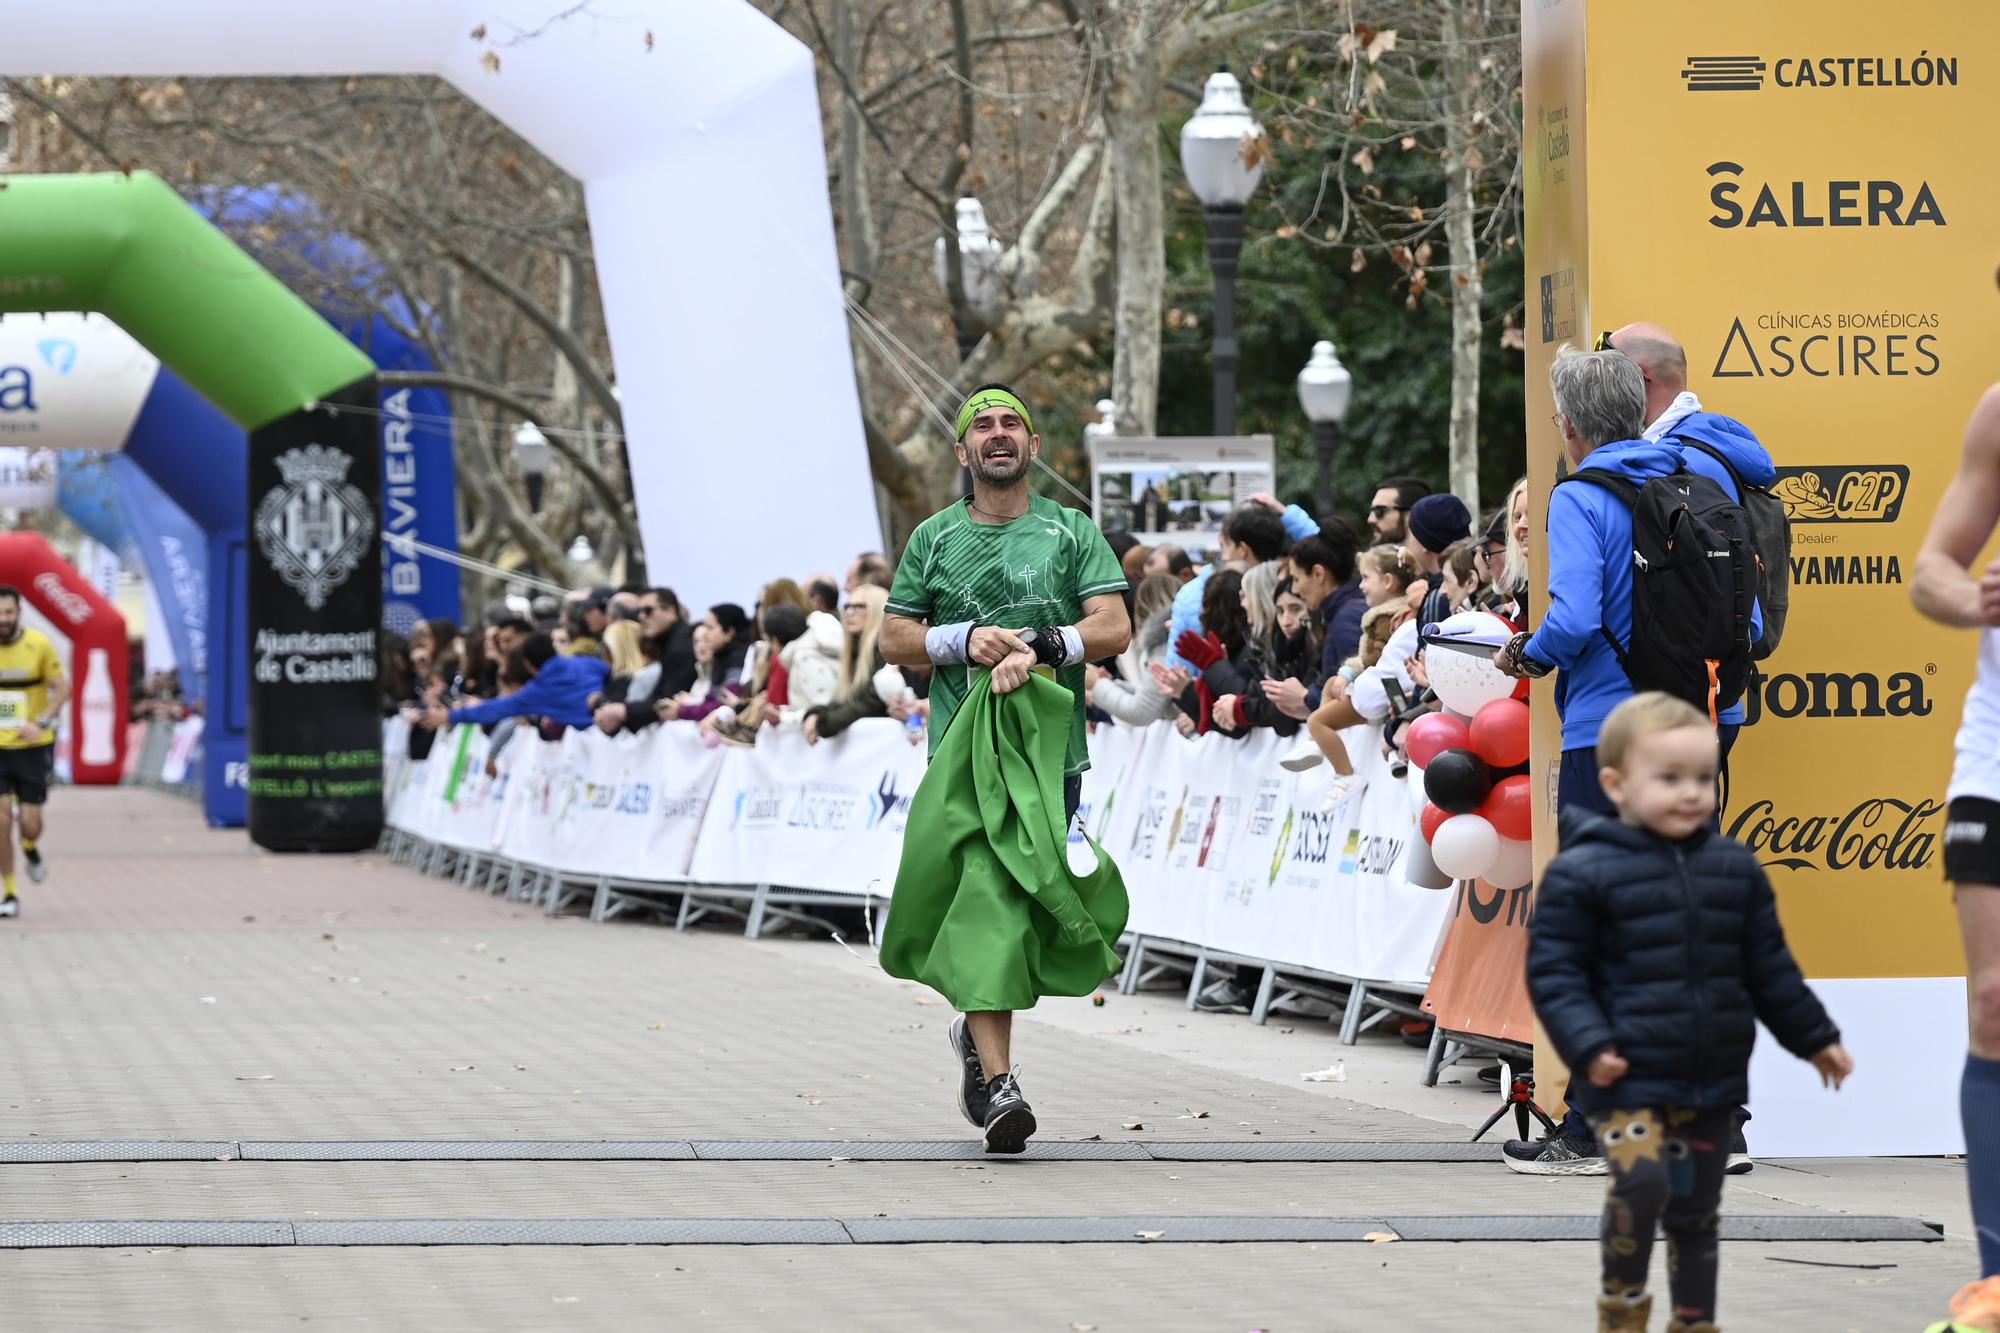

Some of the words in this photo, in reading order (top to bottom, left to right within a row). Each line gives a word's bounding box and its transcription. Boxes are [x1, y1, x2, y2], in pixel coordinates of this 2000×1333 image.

[1774, 50, 1958, 88] CASTELLÓN
[1705, 161, 1948, 229] SALERA
[1757, 311, 1832, 330] CLÍNICAS
[1838, 310, 1940, 328] BIOMÉDICAS
[1711, 315, 1941, 378] ASCIRES
[383, 387, 421, 595] BAVIERA
[1835, 471, 1902, 519] C2P
[1797, 533, 1839, 544] Dealer:
[1790, 555, 1902, 585] YAMAHA
[255, 628, 377, 655] Ajuntament
[255, 651, 283, 683] de
[1723, 798, 1947, 871] Coca-Cola
